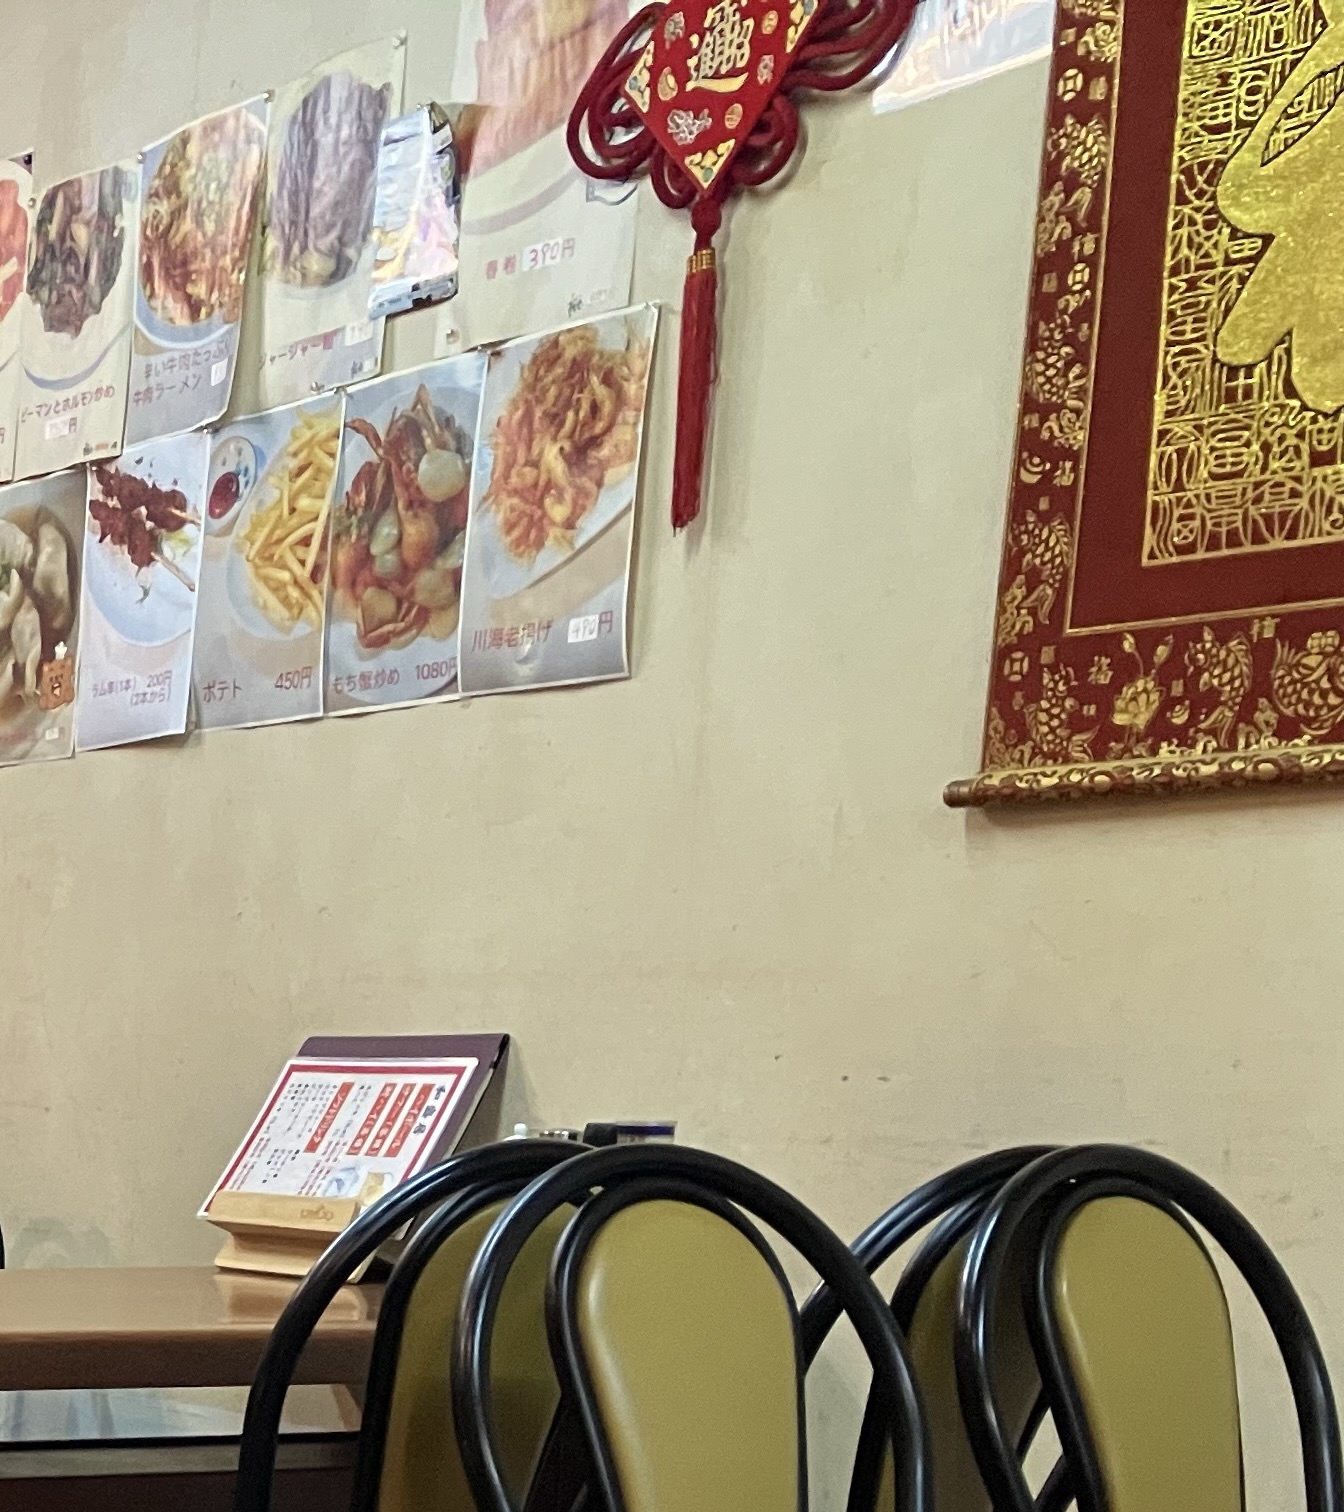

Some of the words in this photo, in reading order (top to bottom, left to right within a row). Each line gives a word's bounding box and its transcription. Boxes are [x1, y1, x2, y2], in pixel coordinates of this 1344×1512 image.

[202, 679, 242, 703] ポテト
[274, 666, 312, 690] 450円
